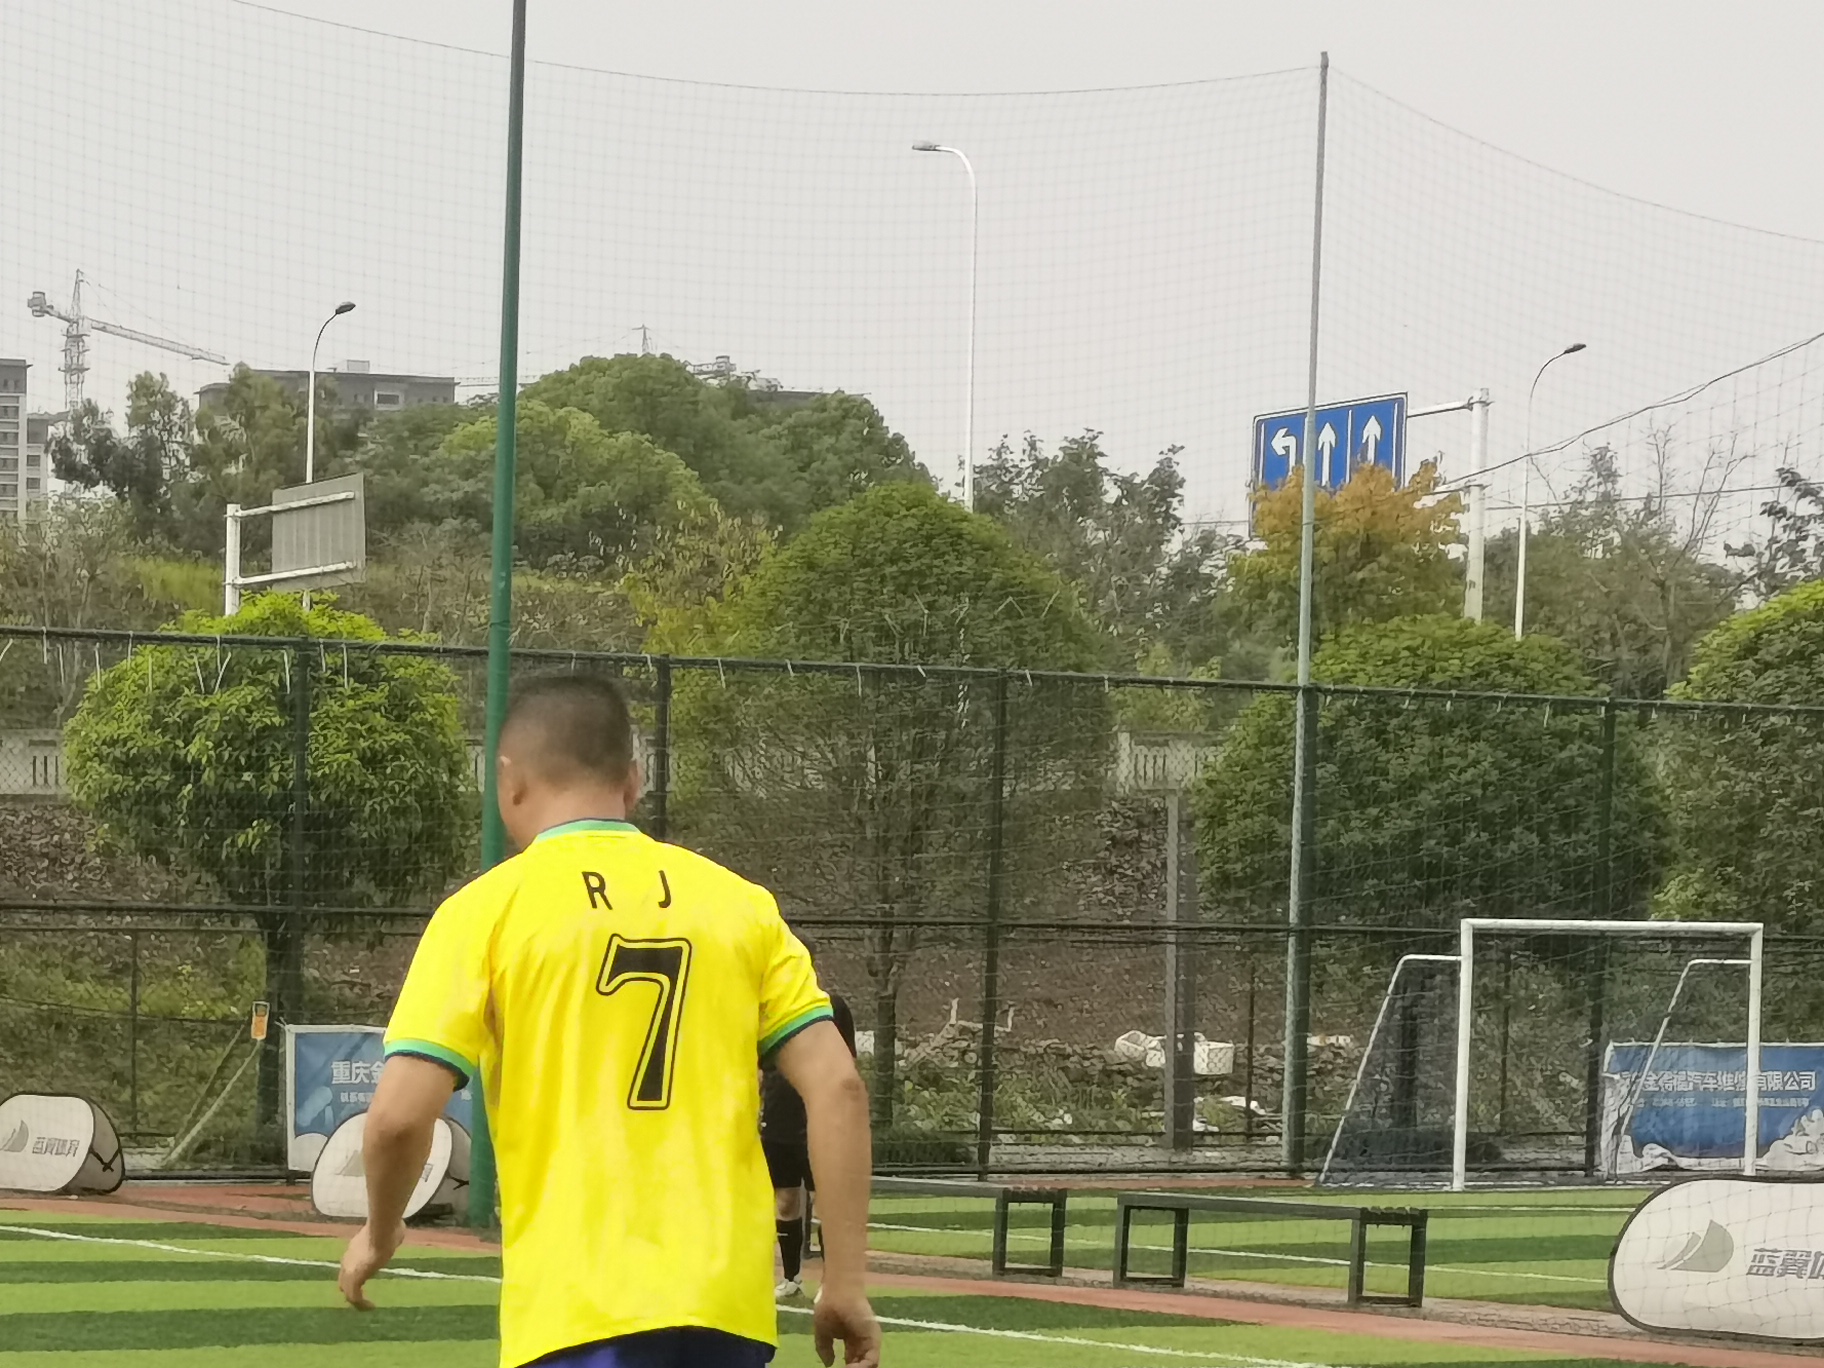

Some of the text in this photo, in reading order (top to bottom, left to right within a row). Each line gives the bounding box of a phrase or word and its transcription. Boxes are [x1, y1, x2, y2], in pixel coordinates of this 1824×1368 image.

[581, 869, 672, 910] R J
[595, 933, 692, 1110] 7
